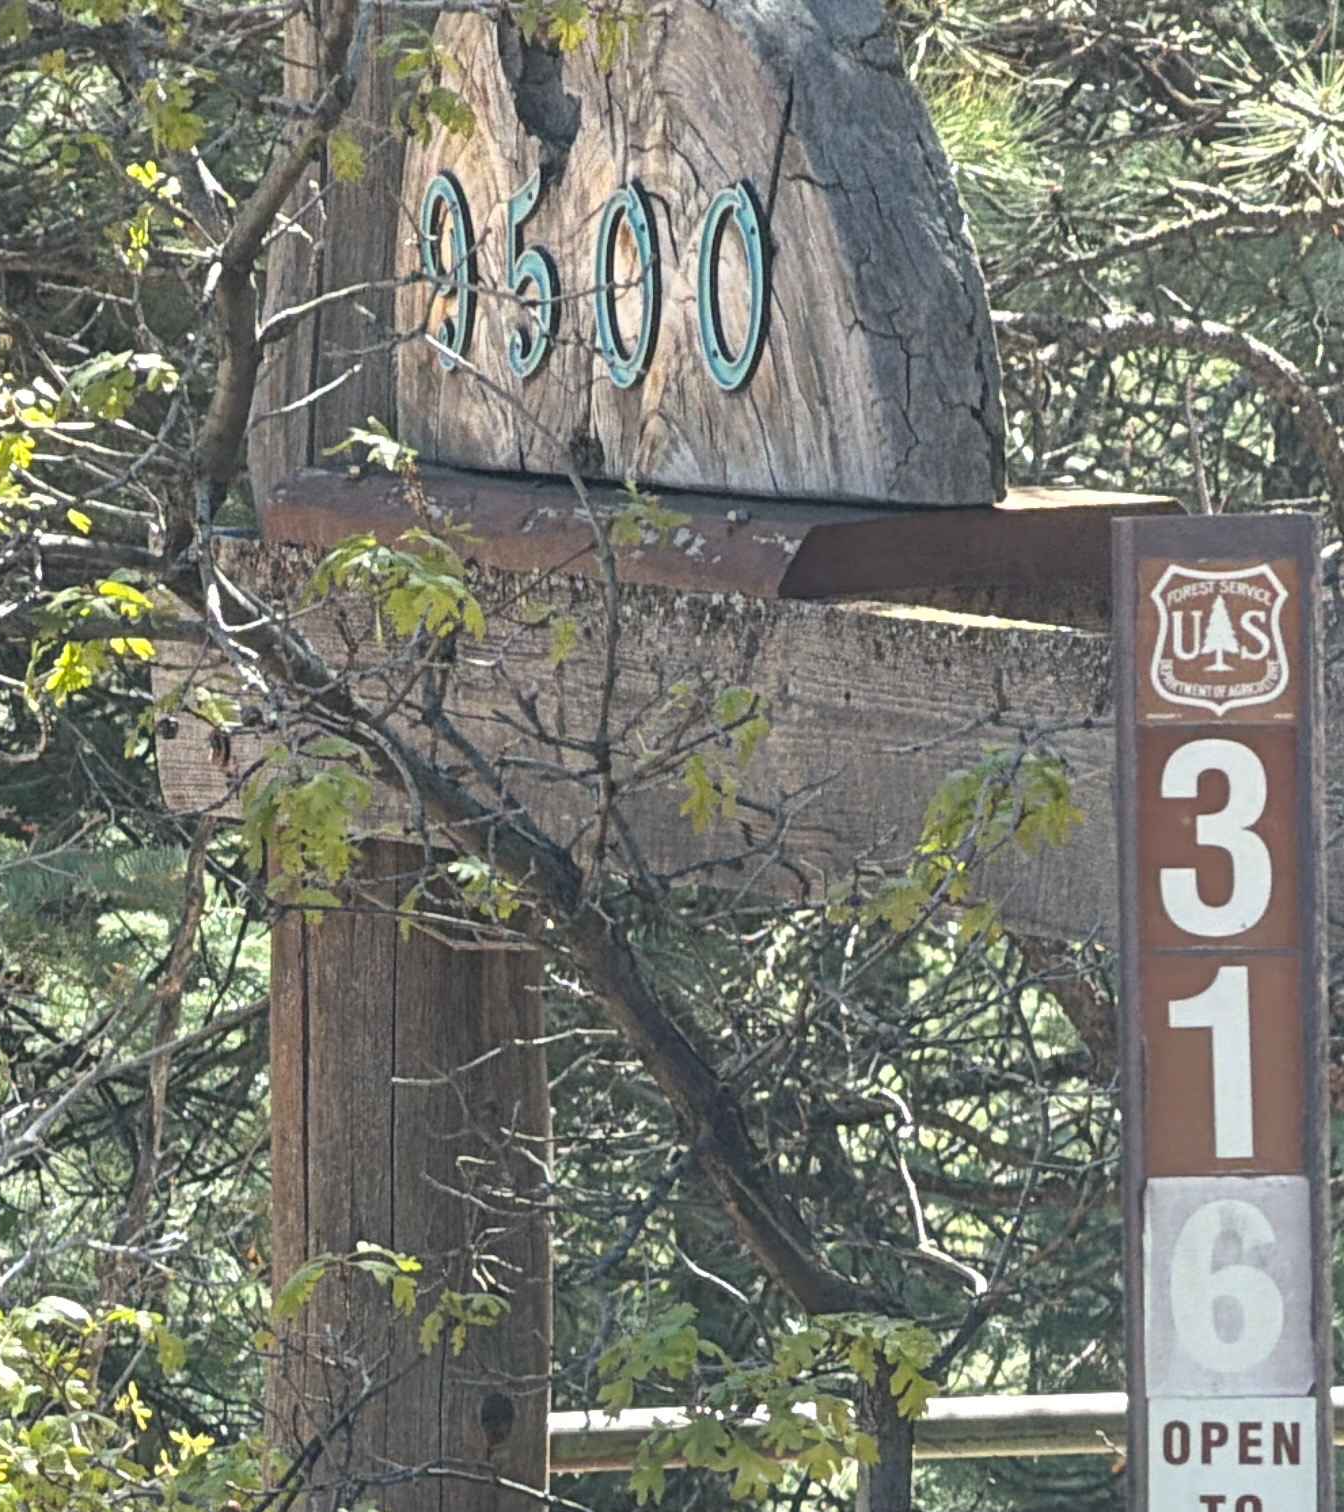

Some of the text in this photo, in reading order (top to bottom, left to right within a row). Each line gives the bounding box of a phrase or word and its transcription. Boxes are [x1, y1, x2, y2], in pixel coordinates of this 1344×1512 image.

[421, 169, 769, 390] 9500
[1166, 580, 1272, 607] FOREST SERVICE
[1159, 658, 1283, 699] DEPARTMENT OF AGRICULTURE
[1162, 1420, 1302, 1466] OPEN
